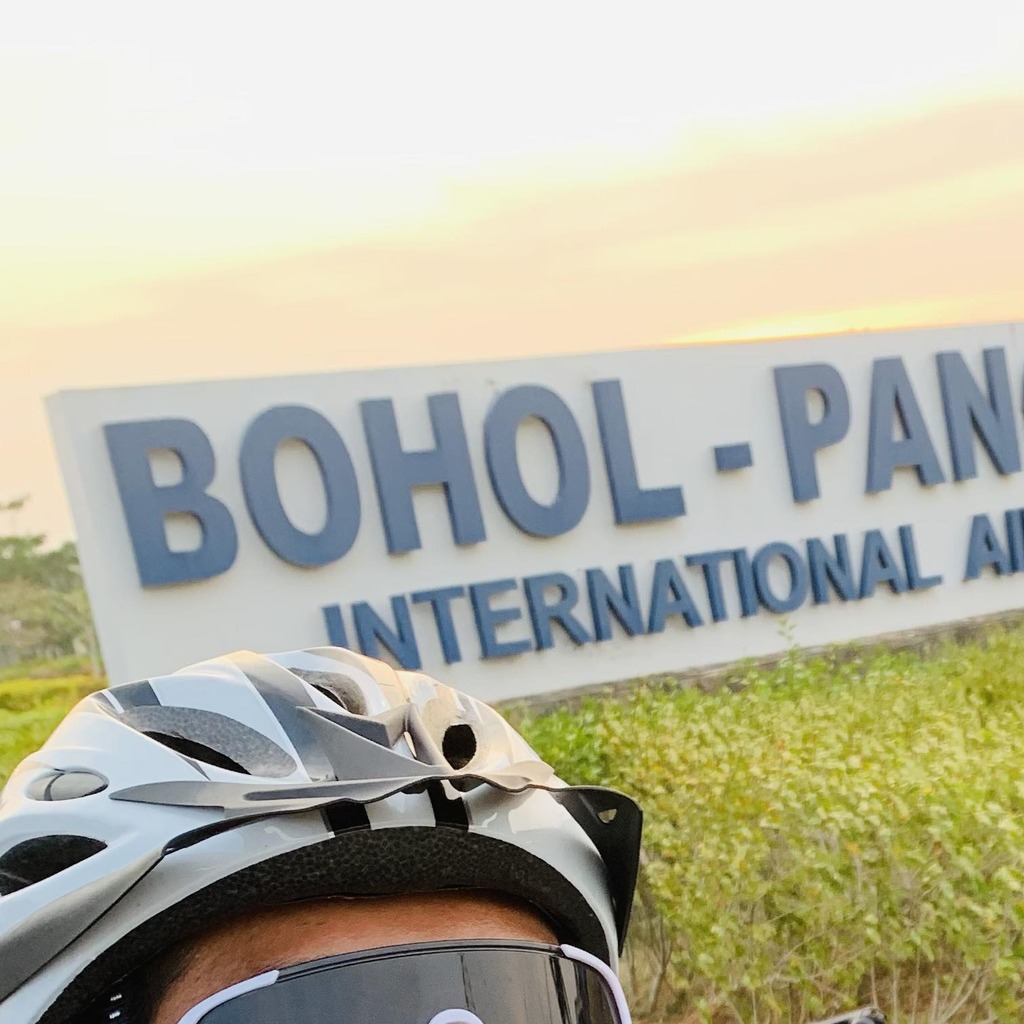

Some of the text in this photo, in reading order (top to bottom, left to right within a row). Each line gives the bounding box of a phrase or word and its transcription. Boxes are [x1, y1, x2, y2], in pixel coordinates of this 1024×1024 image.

[103, 378, 686, 589] BOHOL
[713, 442, 754, 472] -
[321, 524, 943, 671] INTERNATIONAL
